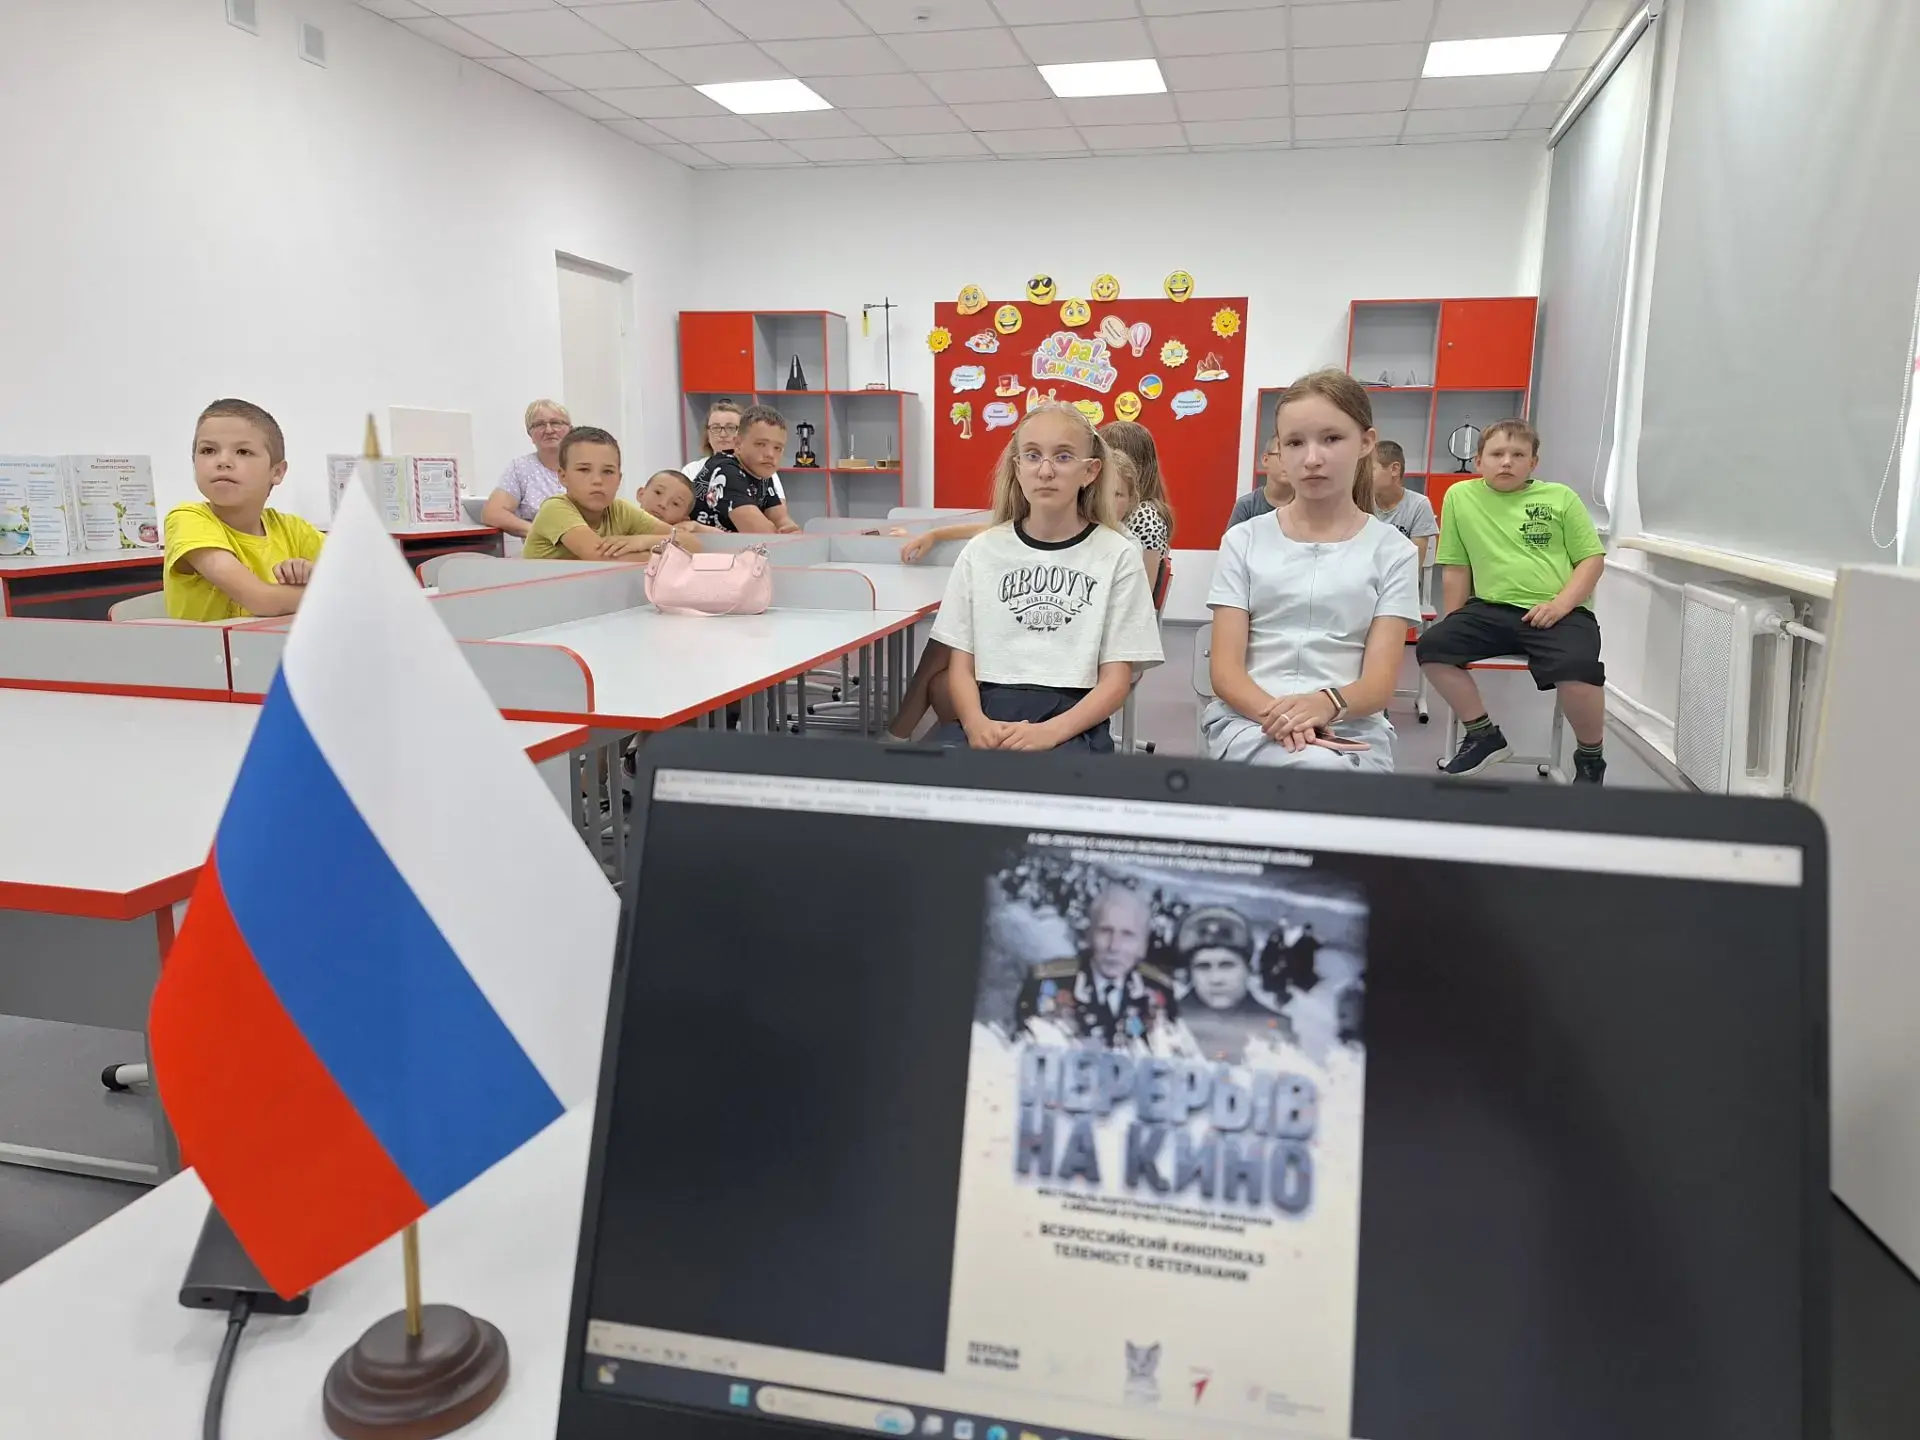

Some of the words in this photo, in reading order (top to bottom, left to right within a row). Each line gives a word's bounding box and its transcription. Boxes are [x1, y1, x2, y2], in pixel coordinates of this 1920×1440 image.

[1056, 336, 1102, 363] Ура!
[1036, 356, 1113, 390] Каникулы!
[998, 564, 1098, 606] GROOVY
[1023, 611, 1063, 625] 1962
[1018, 1043, 1318, 1141] ПЕРЕРЫВ
[1015, 1103, 1103, 1185] НА
[1124, 1121, 1315, 1217] КИНО
[1039, 1222, 1168, 1252] ВСЕРОССИЙСКИЙ
[1172, 1239, 1266, 1265] КИНОПОКАЗ
[1053, 1243, 1131, 1266] ТЕЛЕМОСТ
[1147, 1258, 1250, 1282] ВЕТЕРАНАМИ
